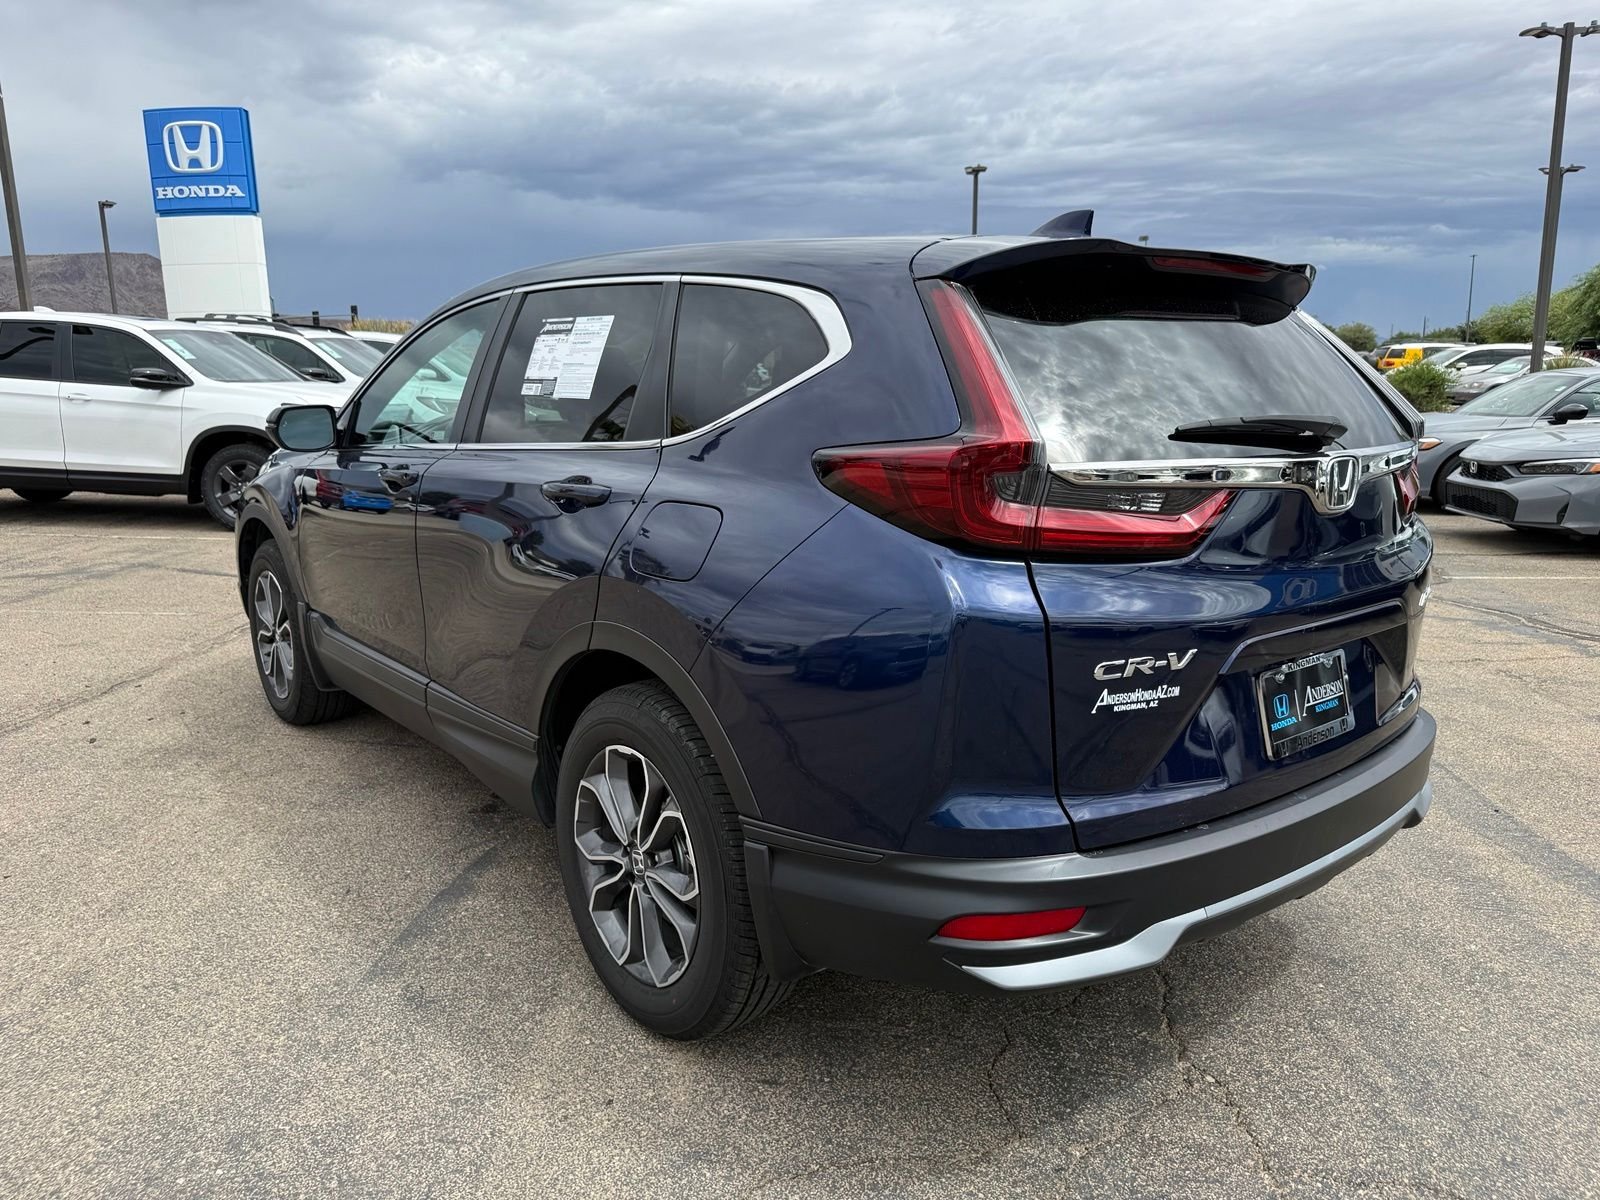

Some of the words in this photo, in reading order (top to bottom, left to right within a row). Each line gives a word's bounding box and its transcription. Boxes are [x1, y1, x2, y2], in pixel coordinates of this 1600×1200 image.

[155, 185, 246, 199] HONDA
[1093, 648, 1198, 681] CR-V
[1287, 655, 1322, 672] KINGMAN
[1302, 678, 1344, 717] ANDERSON
[1314, 698, 1339, 713] KINGMAN
[1113, 702, 1148, 712] KINGMAN,
[1149, 700, 1159, 708] AZ
[1270, 716, 1298, 732] HONDA
[1297, 726, 1335, 749] Anderson
